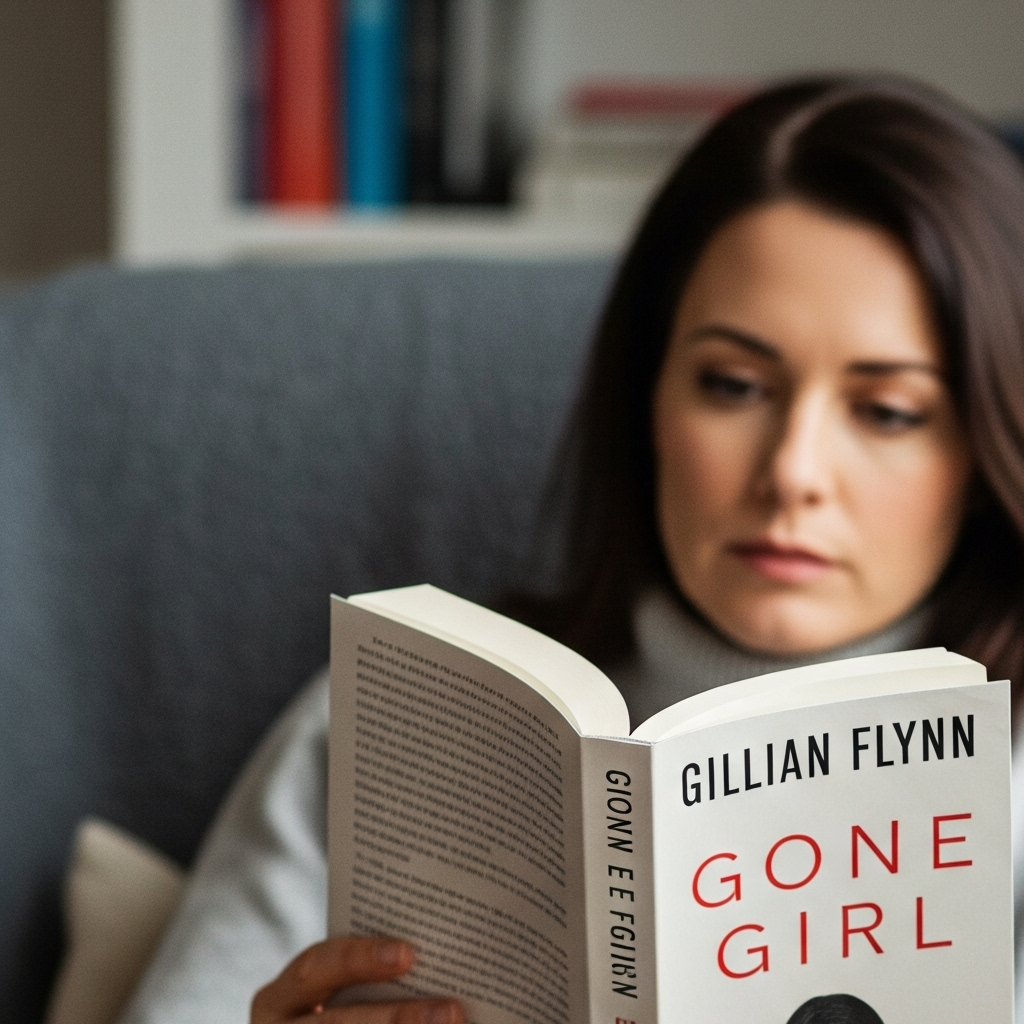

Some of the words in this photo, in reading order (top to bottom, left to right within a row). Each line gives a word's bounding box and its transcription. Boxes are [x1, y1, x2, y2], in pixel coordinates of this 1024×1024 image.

[682, 733, 829, 806] GILLIAN
[853, 715, 974, 770] FLYNN
[693, 813, 972, 908] GONE
[717, 897, 952, 979] GIRL
